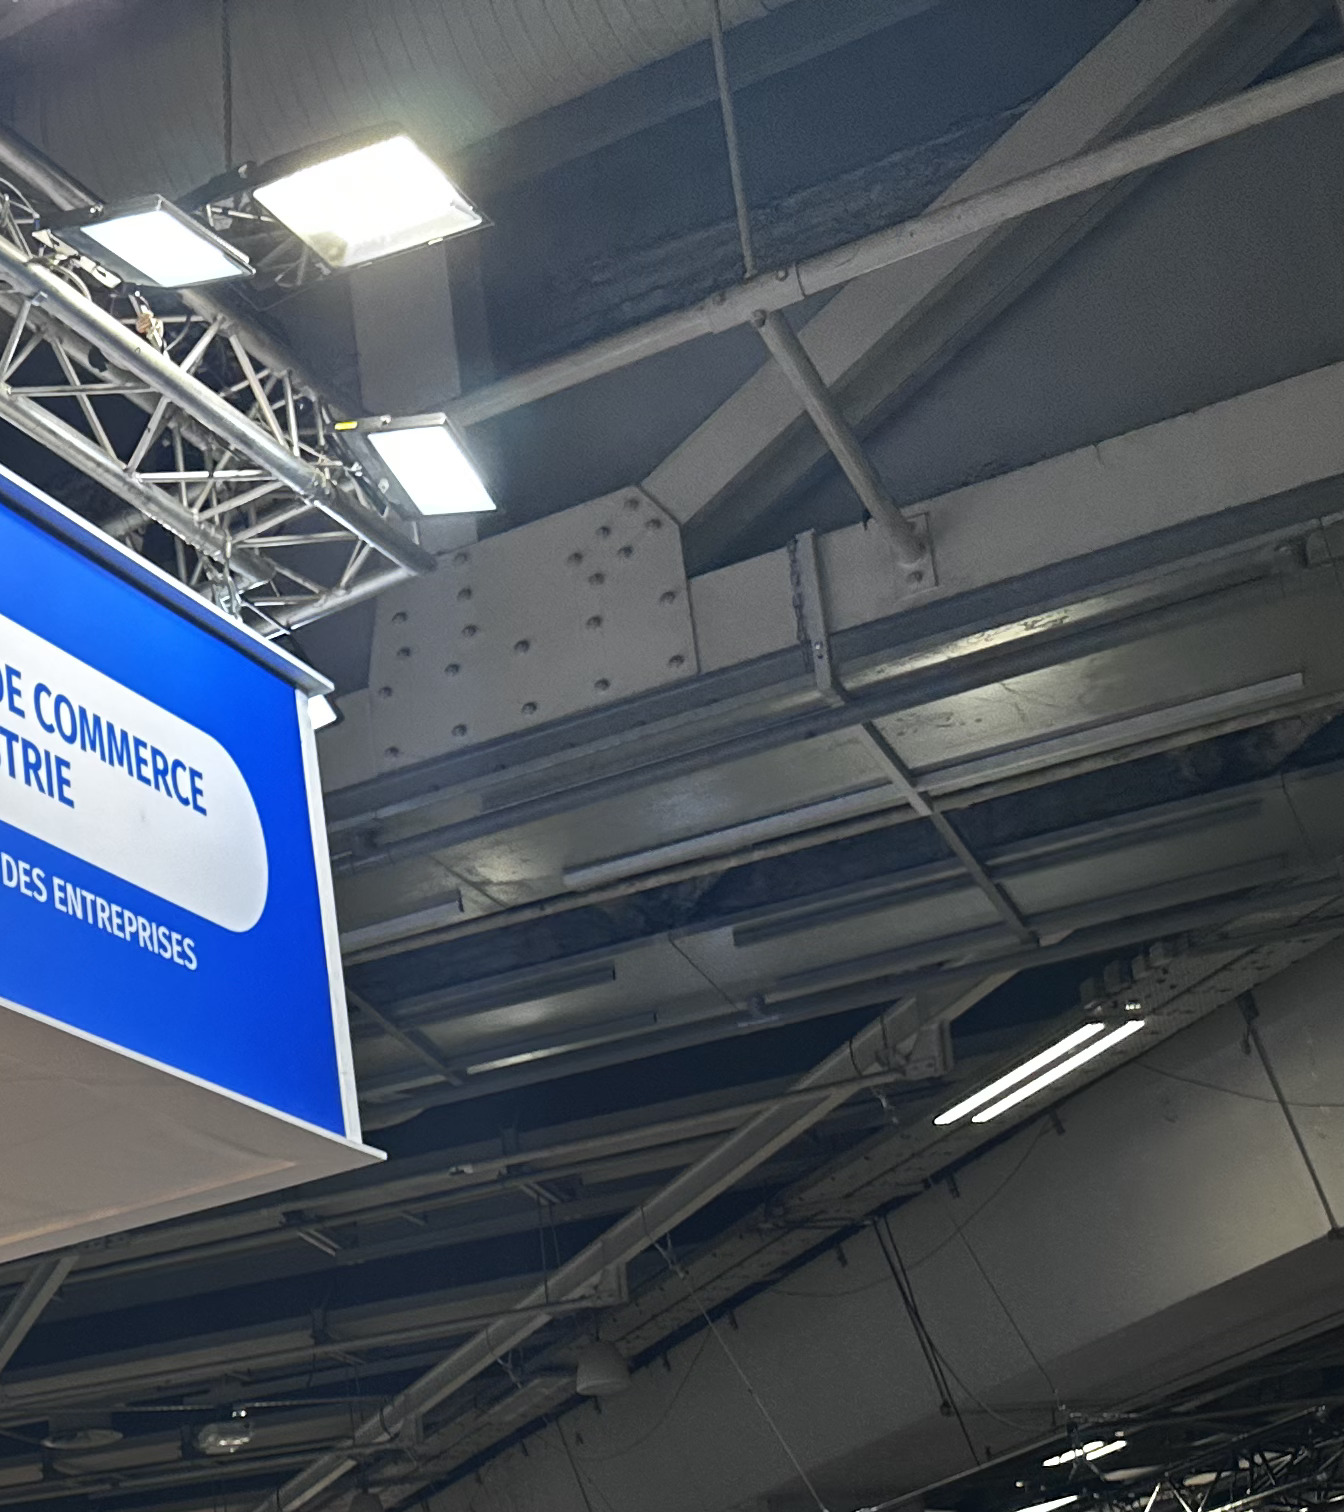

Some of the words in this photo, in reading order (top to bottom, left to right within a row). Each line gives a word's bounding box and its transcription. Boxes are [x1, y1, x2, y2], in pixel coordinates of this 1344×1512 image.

[34, 683, 208, 816] COMMERCE
[1, 851, 47, 903] DES
[53, 875, 199, 971] ENTREPRISES
